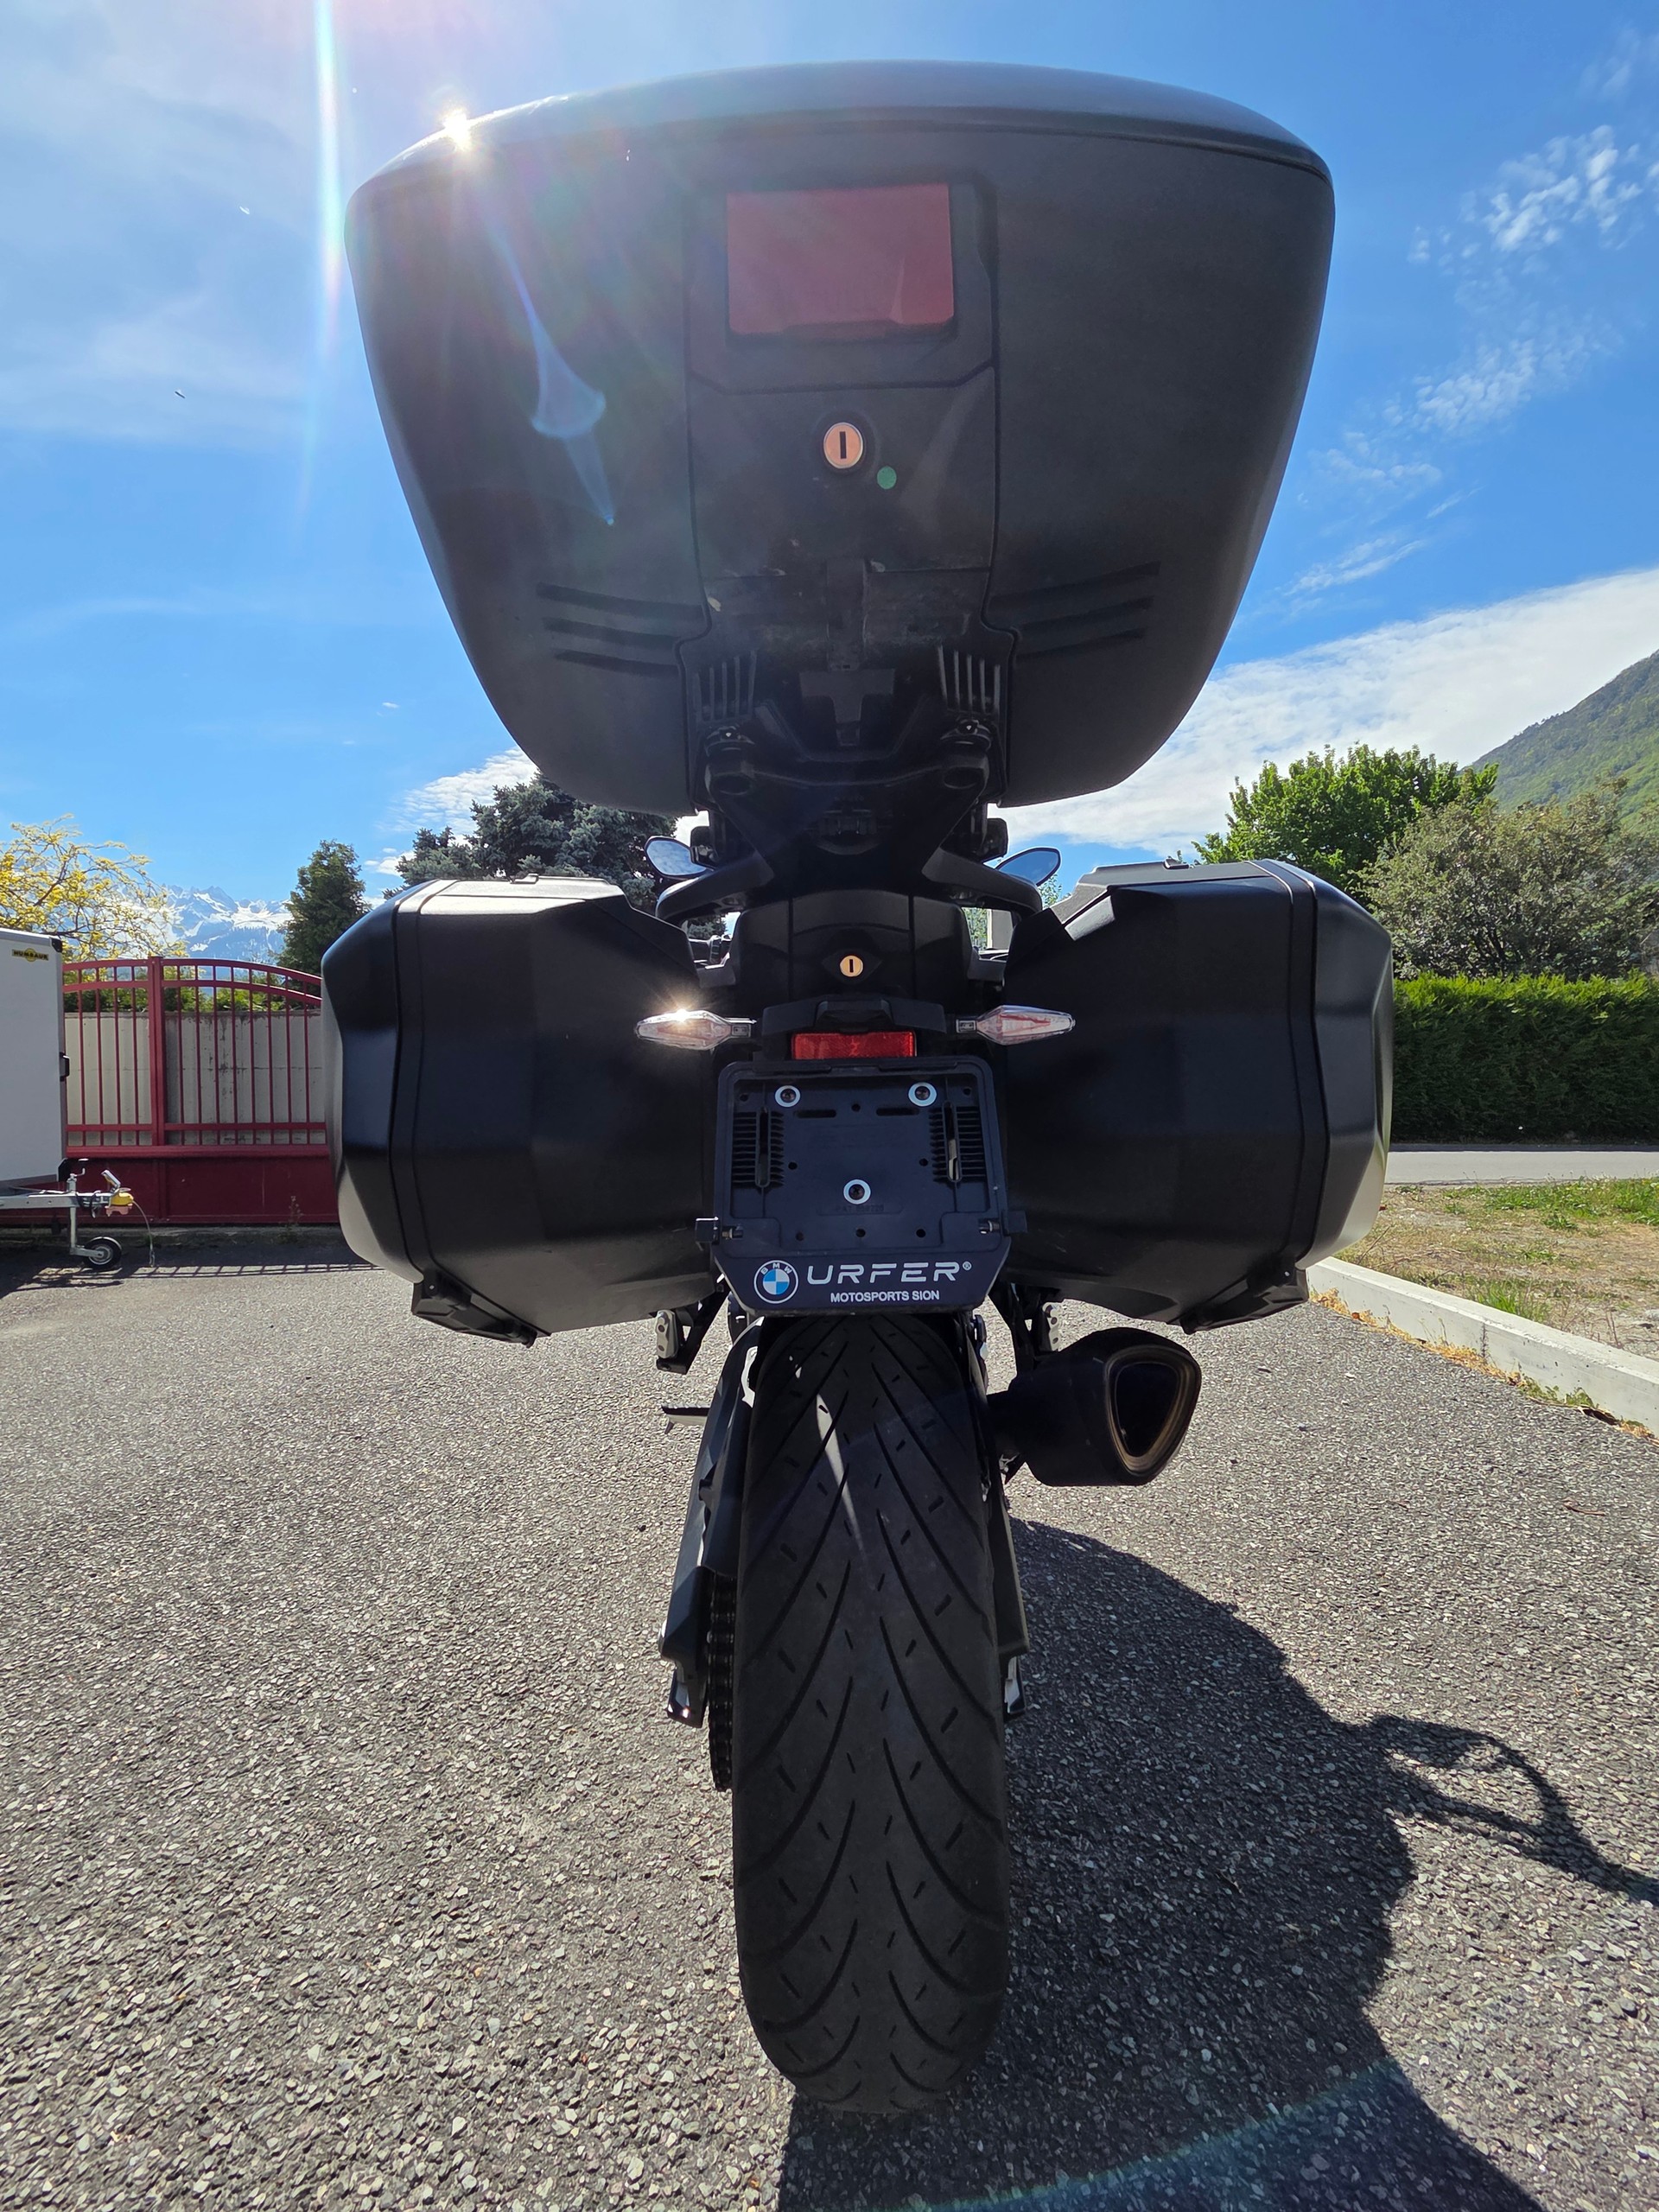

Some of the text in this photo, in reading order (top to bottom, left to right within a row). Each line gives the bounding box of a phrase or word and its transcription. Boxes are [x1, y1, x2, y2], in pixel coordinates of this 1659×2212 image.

[12, 950, 48, 961] HUMBAUR
[760, 1262, 792, 1275] BMW
[830, 1290, 940, 1303] MOTOSPORTS SION
